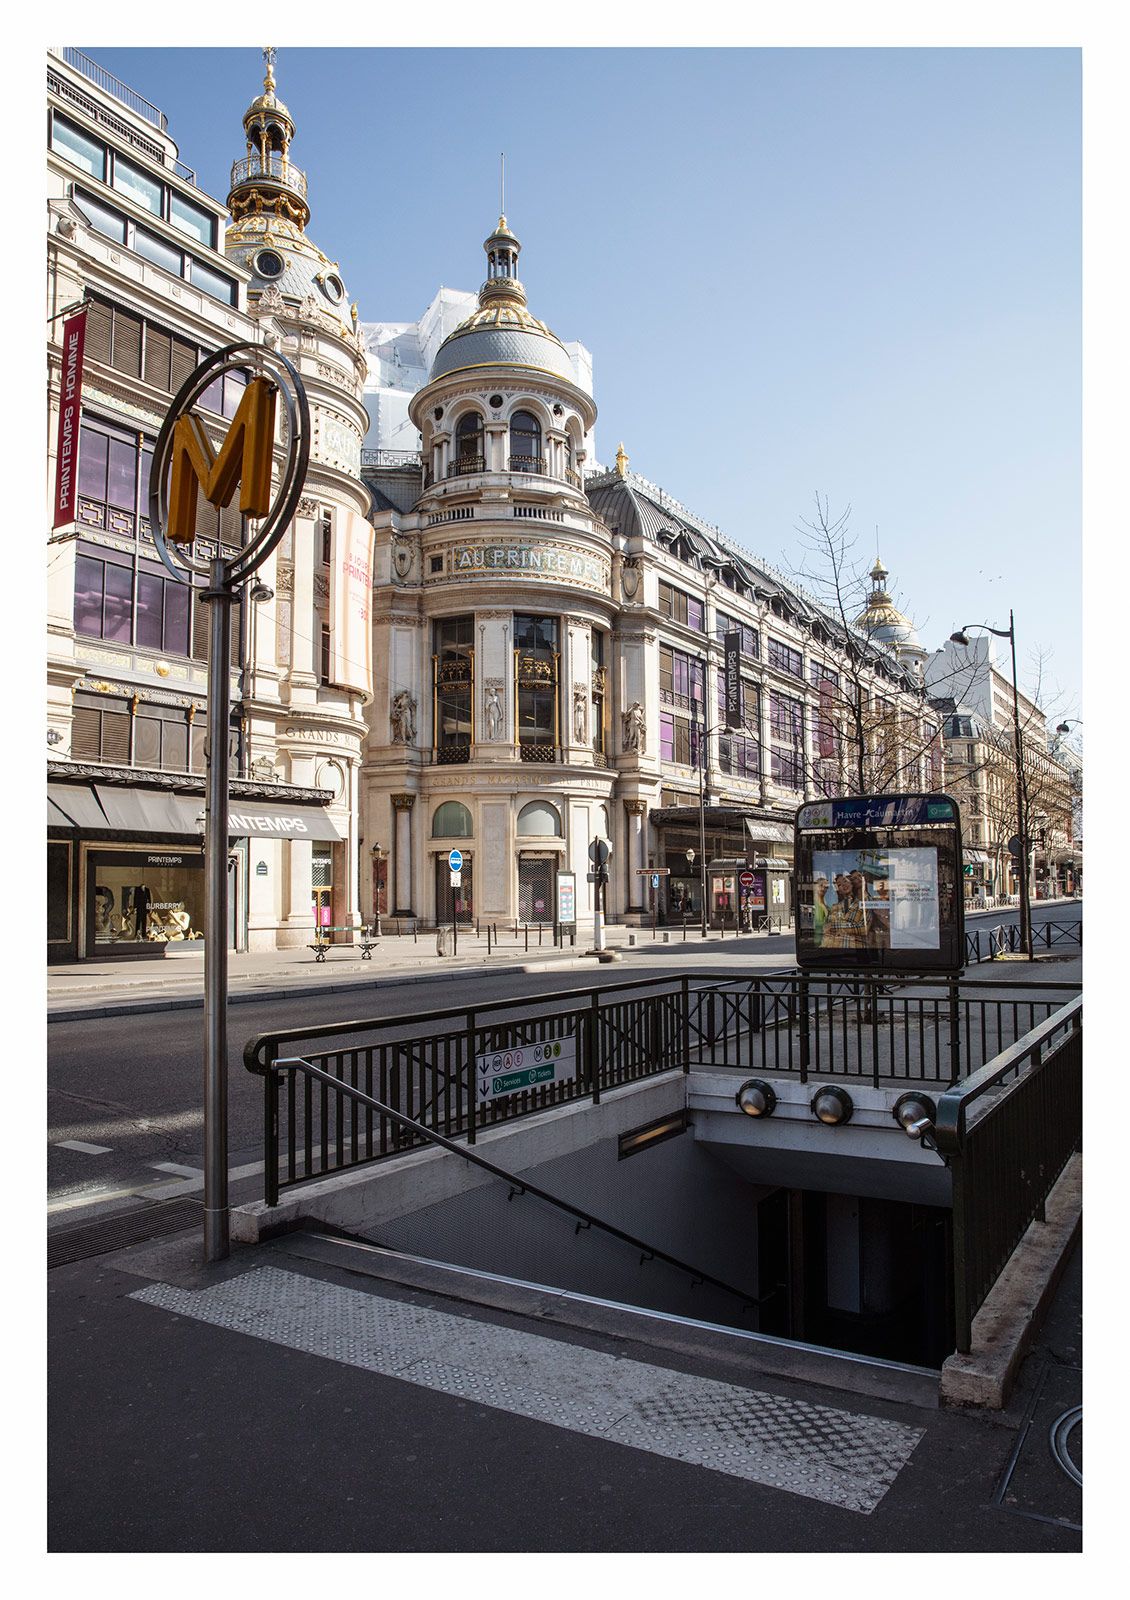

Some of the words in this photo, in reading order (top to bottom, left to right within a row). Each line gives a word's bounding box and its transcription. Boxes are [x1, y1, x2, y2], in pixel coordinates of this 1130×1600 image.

[66, 330, 80, 399] HOMME
[59, 406, 74, 511] PRINTEMPS
[167, 376, 278, 544] M
[458, 551, 485, 568] AU
[493, 549, 600, 582] PRINTEMPS
[728, 649, 738, 713] PRINTEMPS
[285, 726, 339, 743] GRANDS
[432, 775, 476, 786] GRANDS
[228, 814, 308, 833] INTEMPS
[837, 811, 862, 819] Havre
[147, 855, 183, 864] PRINTEMPS
[145, 902, 182, 910] BURBERRY
[503, 1077, 521, 1088] Services
